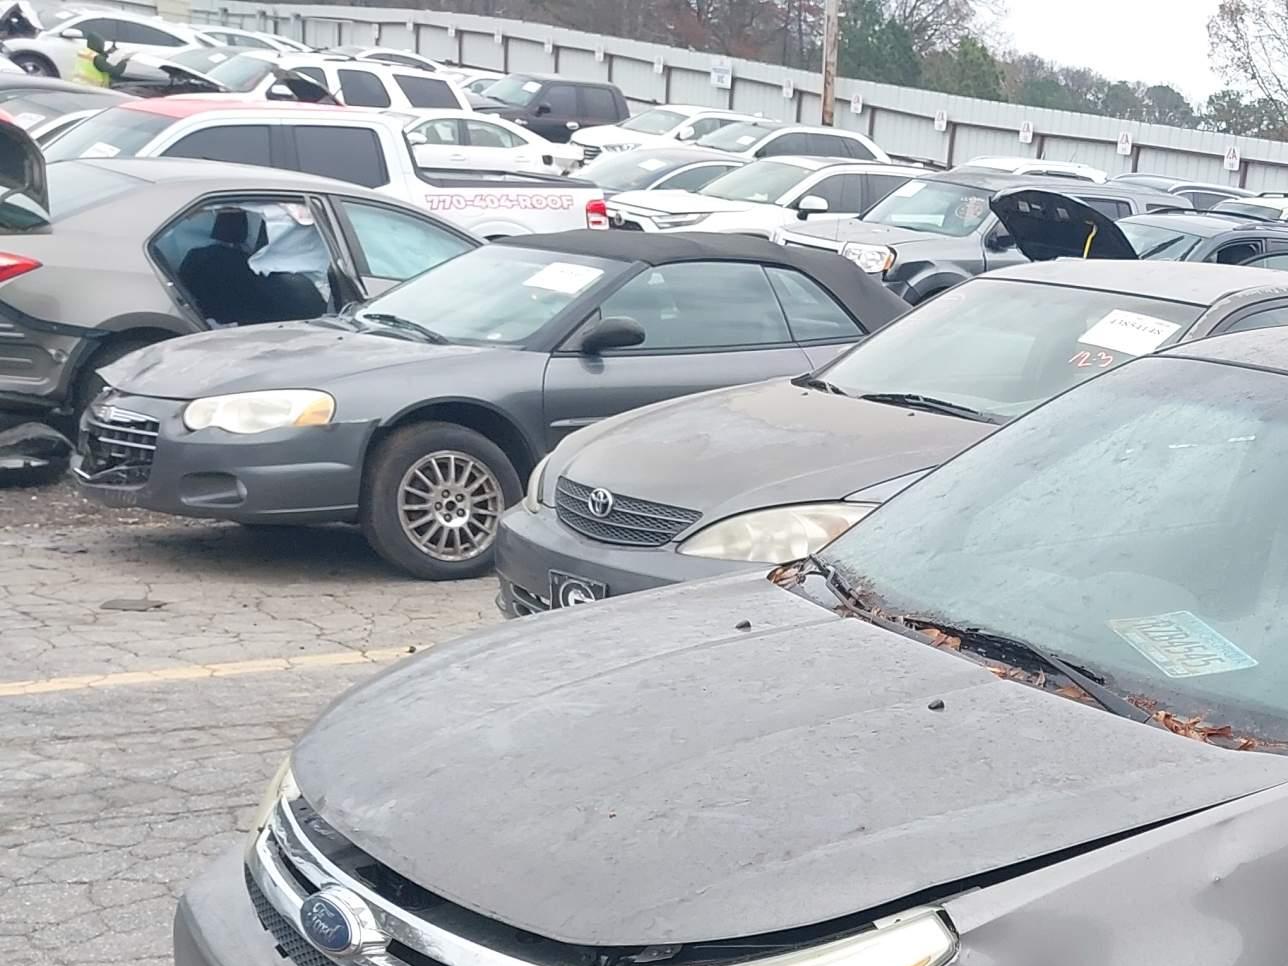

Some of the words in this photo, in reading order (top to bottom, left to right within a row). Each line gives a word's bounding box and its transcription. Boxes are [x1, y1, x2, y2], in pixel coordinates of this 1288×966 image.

[425, 194, 575, 211] 770-404-ROOF
[1135, 619, 1226, 668] RZB4545
[307, 902, 346, 943] Ford
